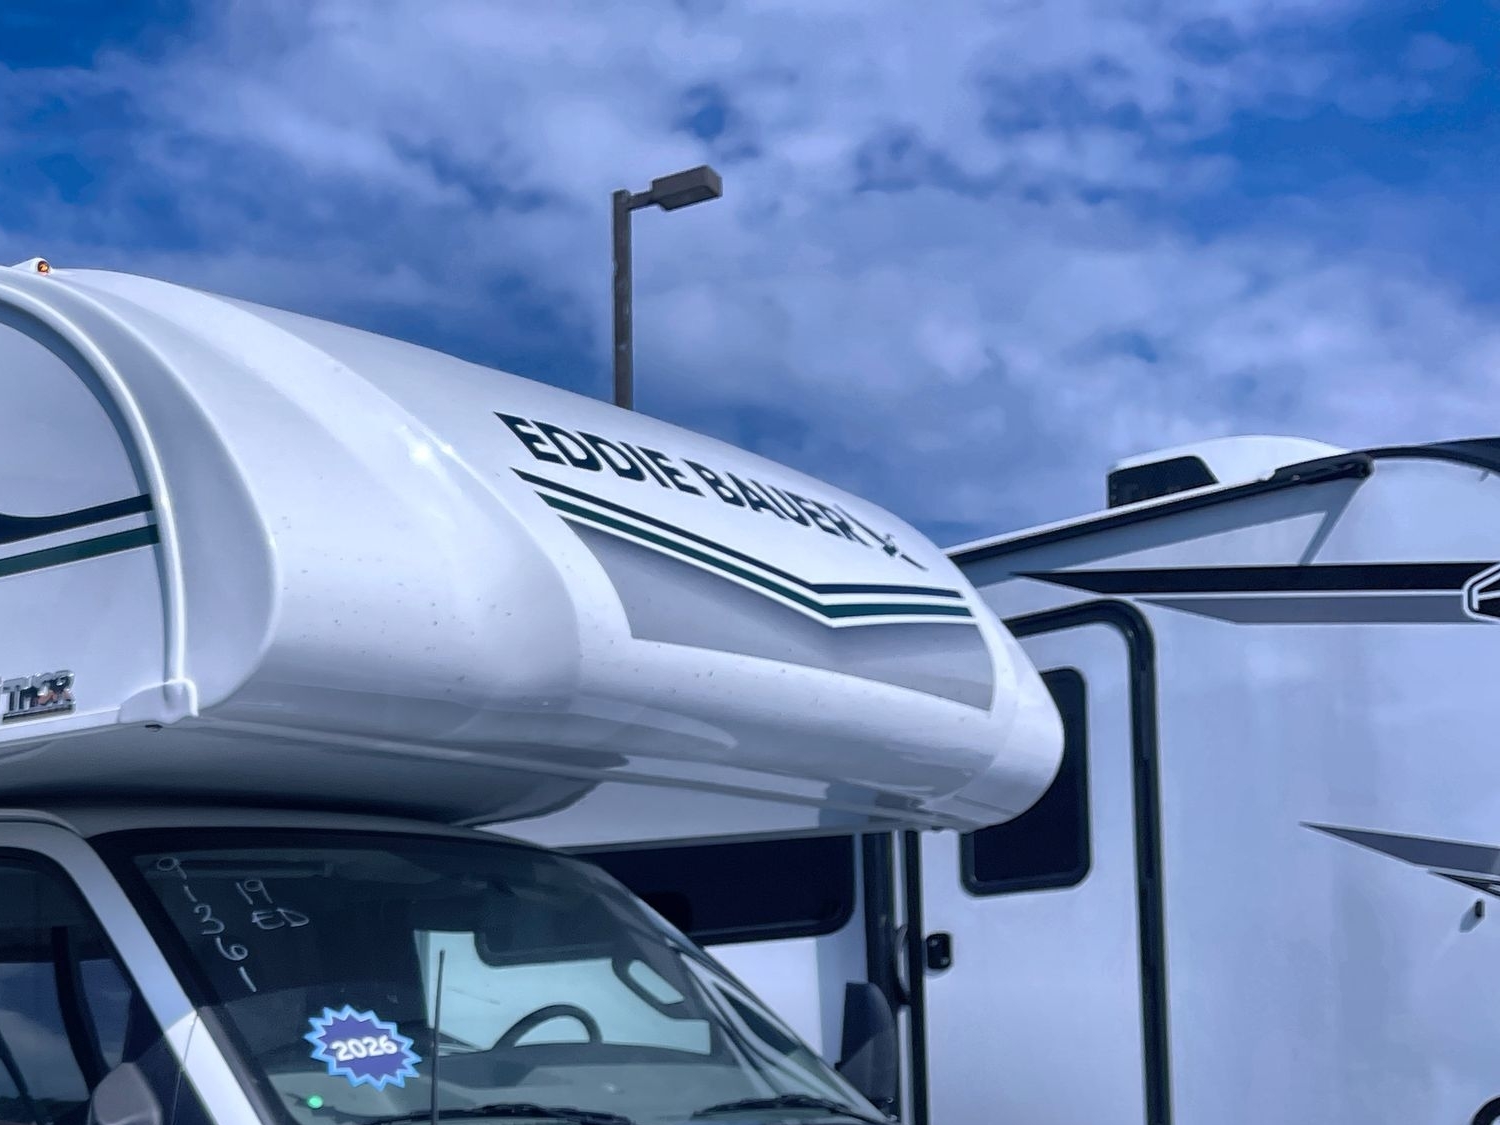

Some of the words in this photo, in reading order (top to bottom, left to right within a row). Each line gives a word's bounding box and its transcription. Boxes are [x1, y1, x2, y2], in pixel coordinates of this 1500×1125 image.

[493, 410, 701, 497] EDDIE
[679, 457, 874, 548] BAUER
[329, 1034, 398, 1062] 2026
